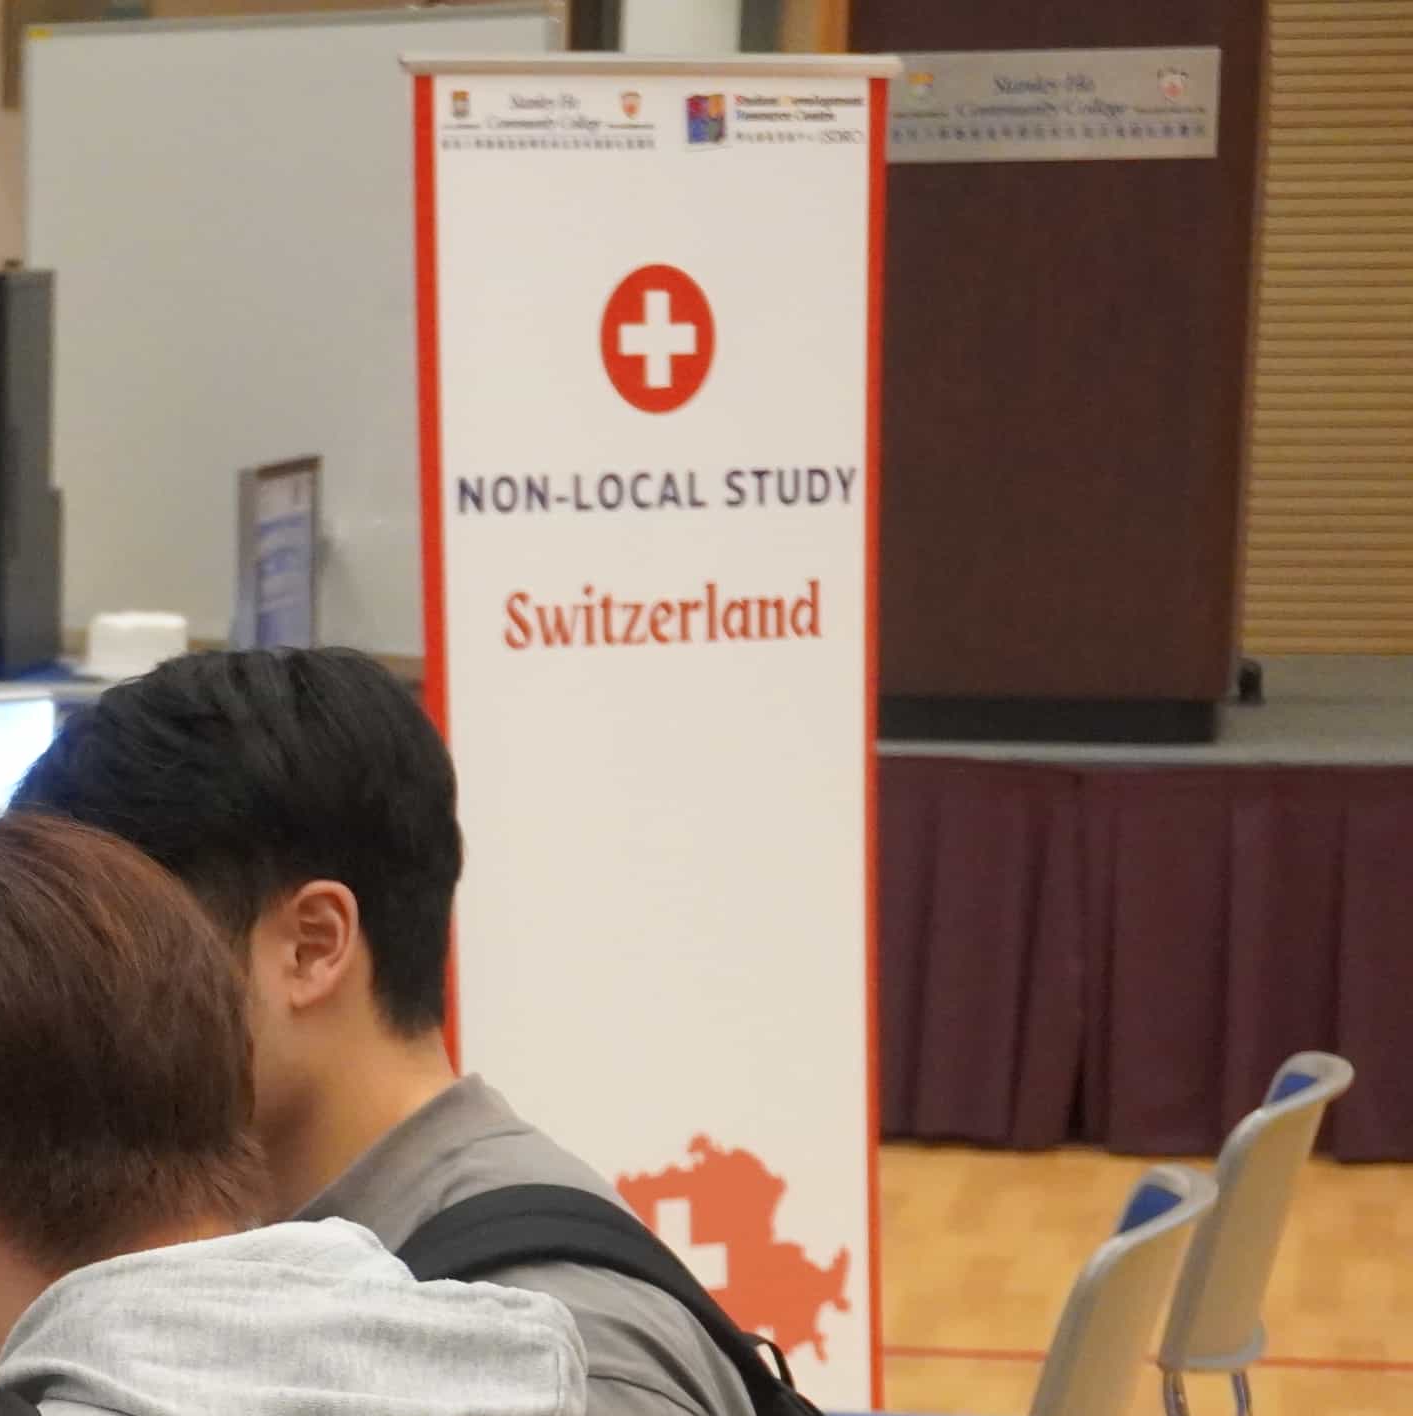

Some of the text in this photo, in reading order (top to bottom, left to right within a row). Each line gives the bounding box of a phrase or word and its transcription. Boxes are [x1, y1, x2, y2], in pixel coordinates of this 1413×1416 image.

[457, 466, 857, 513] NON-LOCAL STUDY
[504, 581, 821, 650] Switzerland
